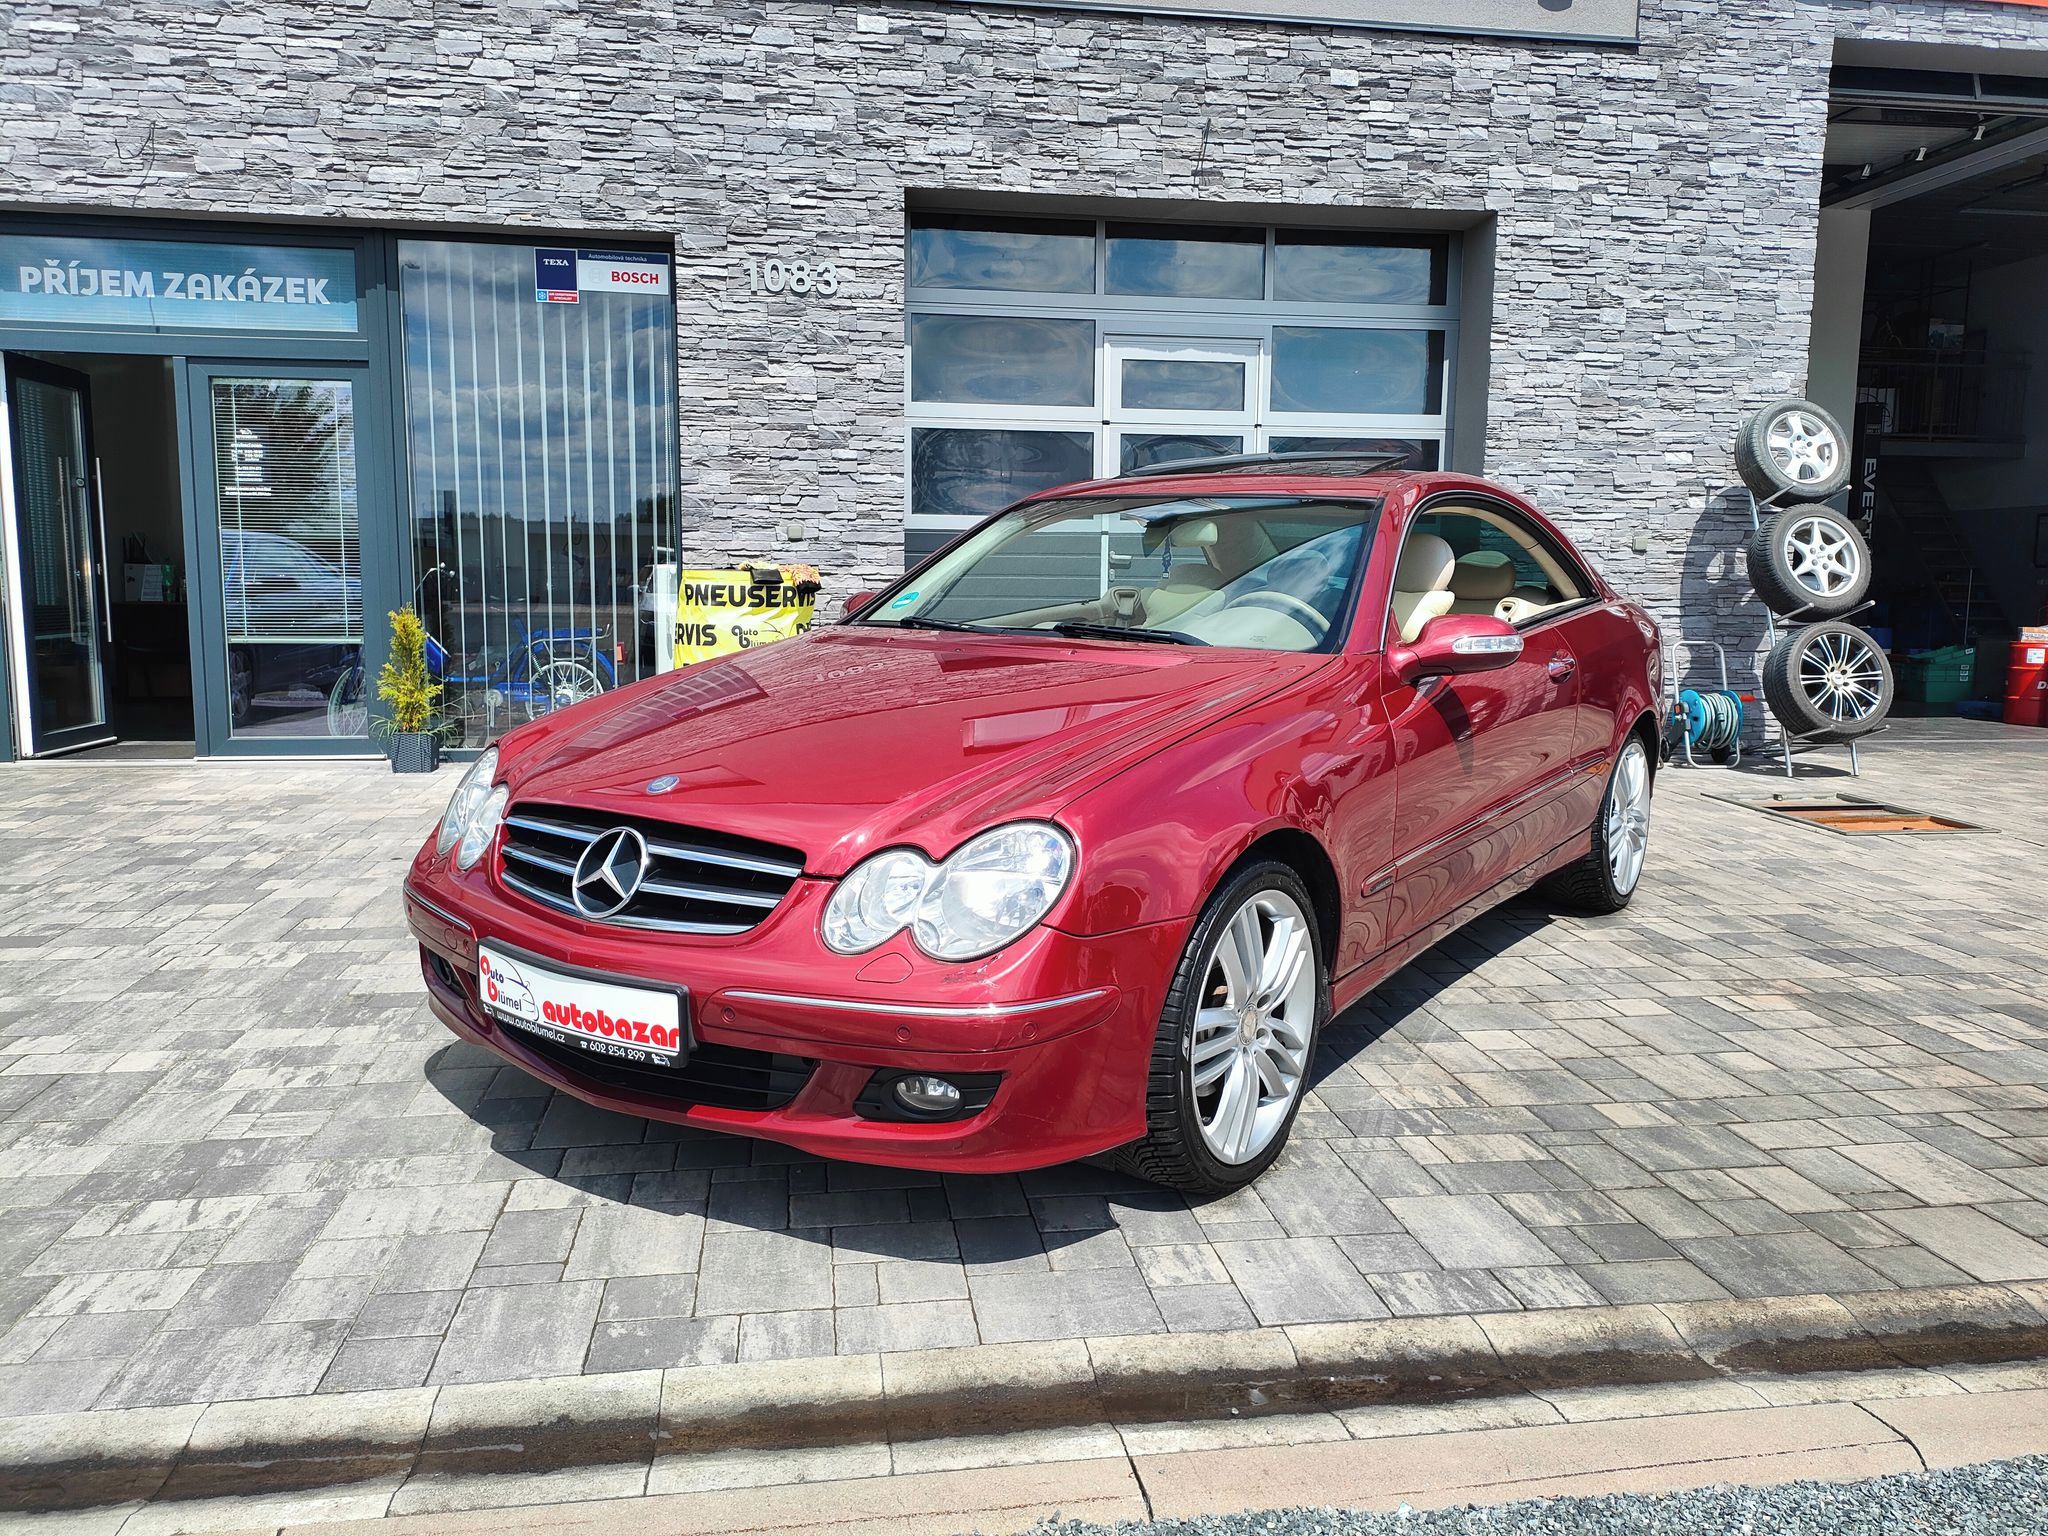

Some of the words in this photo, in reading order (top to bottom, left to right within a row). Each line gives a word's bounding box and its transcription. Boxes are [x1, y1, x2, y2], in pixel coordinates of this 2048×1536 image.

[543, 258, 569, 266] TEXA
[611, 271, 659, 285] BOSCH
[741, 258, 838, 296] 1083
[20, 259, 155, 298] PŘÍJEM
[163, 268, 331, 304] ZAKÁZEK
[487, 976, 522, 1012] blümel
[497, 1010, 566, 1043] www.autoblumel.cz
[542, 1000, 680, 1049] autobazar
[589, 1041, 607, 1054] 602
[608, 1045, 626, 1058] 254
[627, 1049, 646, 1061] 299
